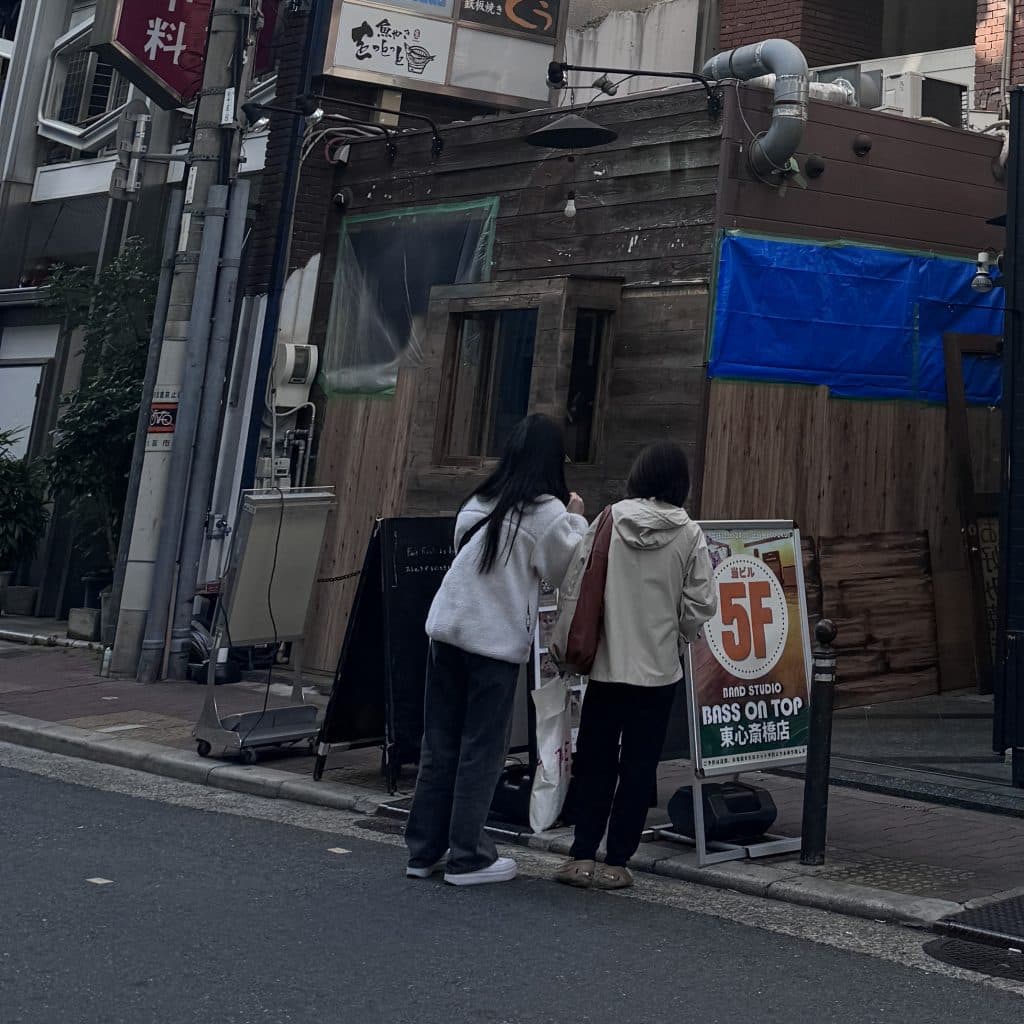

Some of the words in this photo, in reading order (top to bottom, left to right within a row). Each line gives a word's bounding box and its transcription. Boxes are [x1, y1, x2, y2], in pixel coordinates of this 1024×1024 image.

[731, 566, 755, 579] 当ビル
[719, 581, 773, 662] 5F
[722, 686, 746, 699] BAND
[748, 682, 782, 696] STUDIO
[702, 702, 741, 725] BASS
[745, 699, 768, 721] ON
[770, 696, 803, 718] TOP
[719, 719, 791, 748] 東心斎橋店
